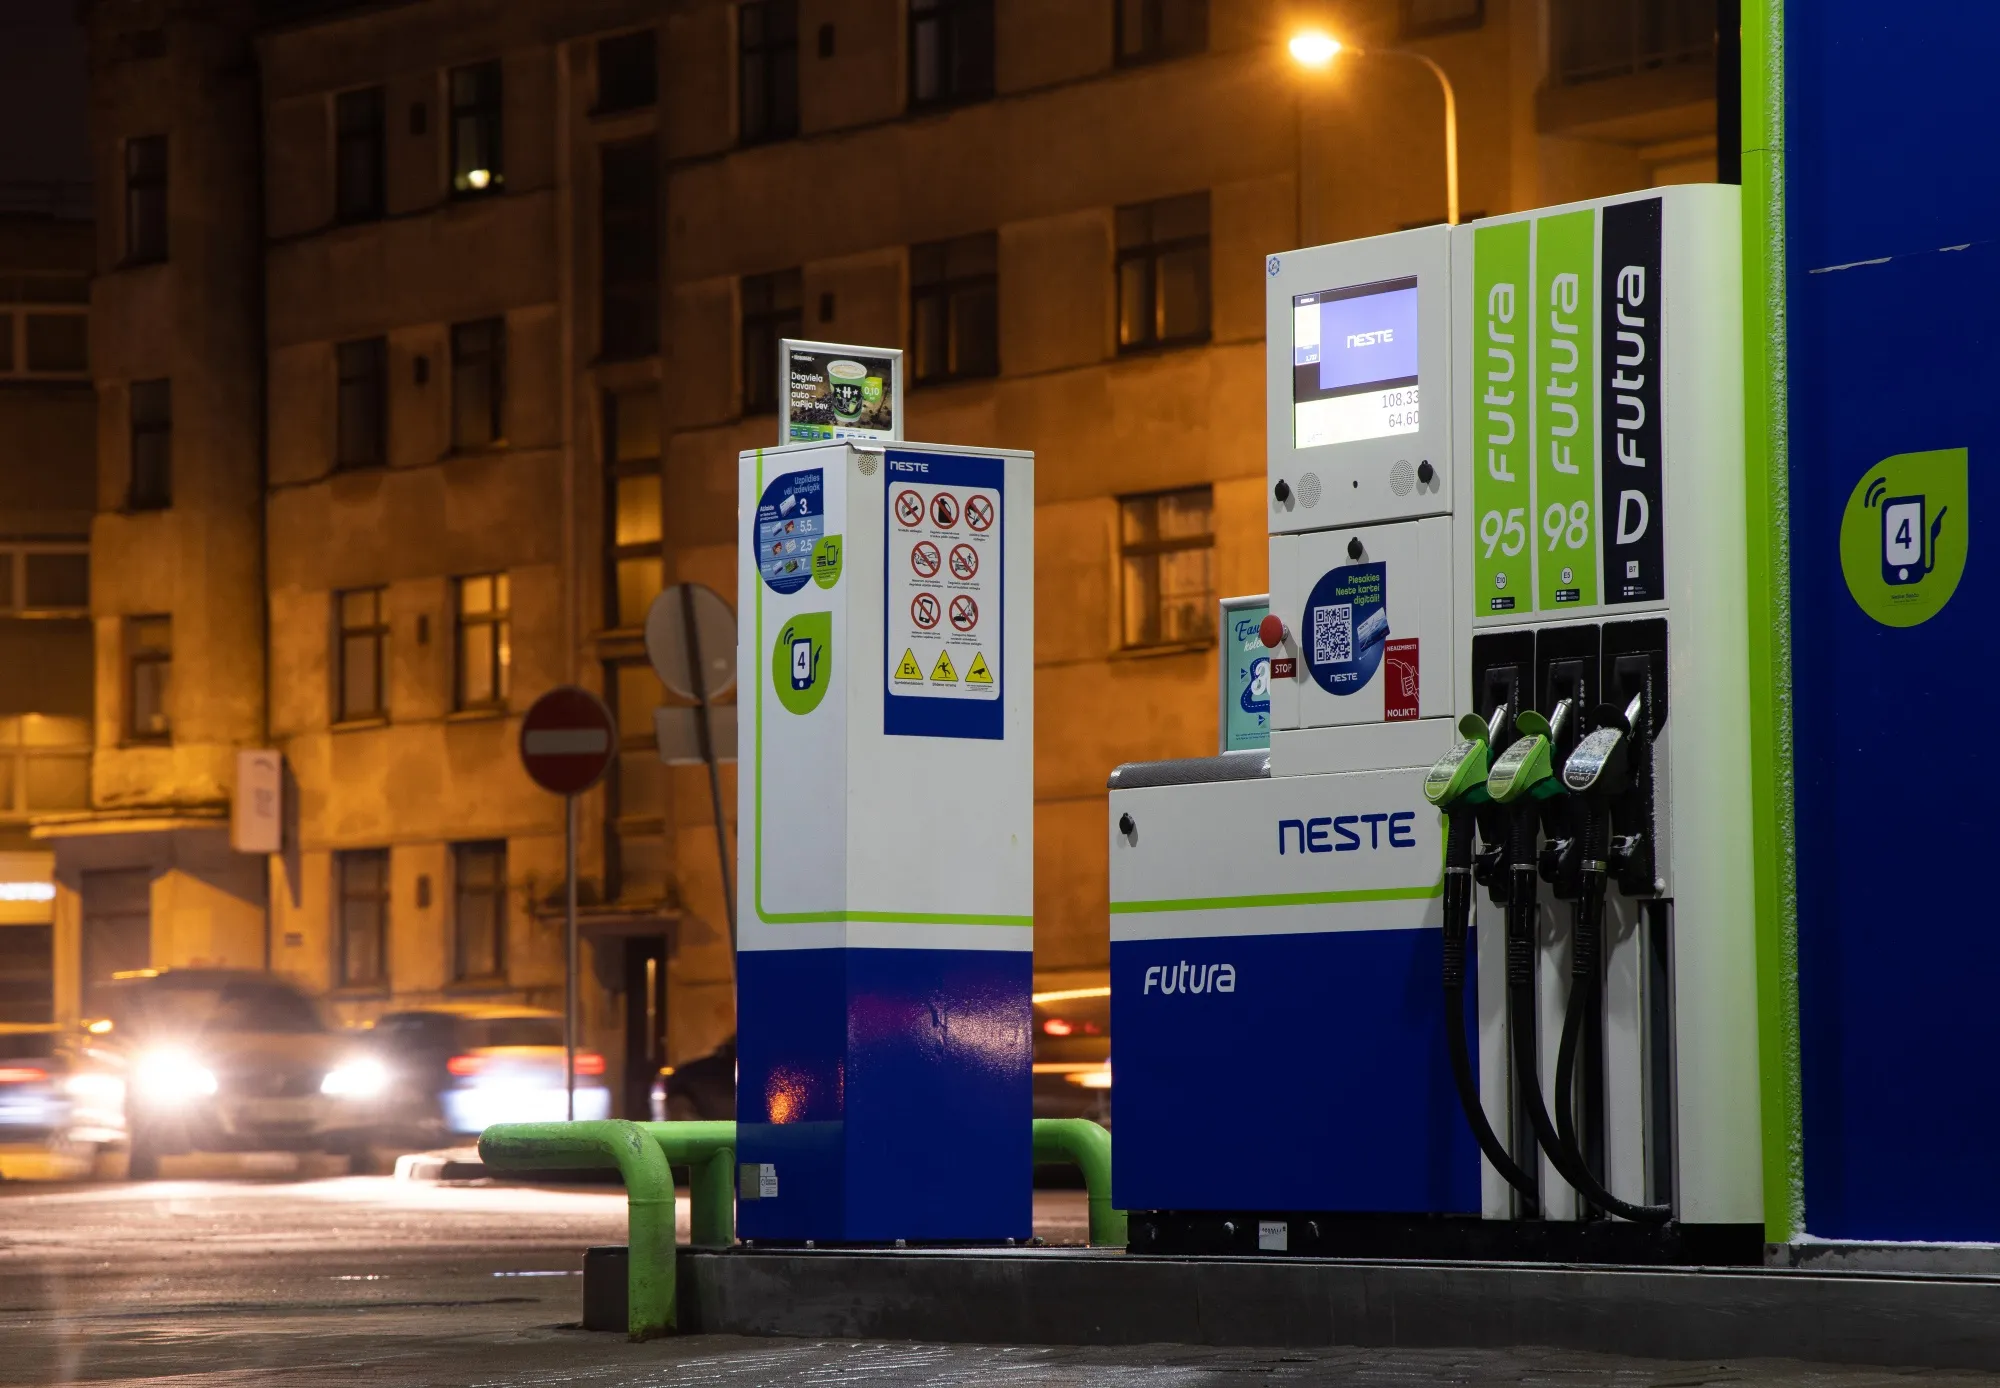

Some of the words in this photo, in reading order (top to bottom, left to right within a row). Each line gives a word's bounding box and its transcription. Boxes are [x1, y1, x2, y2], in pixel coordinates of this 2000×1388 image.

[1346, 329, 1394, 349] NESTE
[791, 371, 824, 383] Degviela
[791, 381, 817, 391] tavam
[863, 386, 880, 396] 0,10
[791, 391, 810, 399] auto
[791, 399, 813, 411] kafija
[814, 401, 828, 410] tev
[889, 460, 929, 473] NESTE
[794, 474, 820, 486] Uzpildies
[799, 498, 807, 515] 3
[1615, 489, 1649, 545] D
[800, 519, 812, 533] 5,5
[1542, 500, 1589, 552] 98
[1480, 508, 1525, 559] 95
[1895, 518, 1912, 549] 4
[800, 539, 812, 553] 2,5
[1348, 573, 1380, 585] Piesakies
[1563, 571, 1571, 579] E5
[1335, 587, 1356, 597] Neste
[1358, 584, 1380, 594] kartei
[1353, 595, 1380, 607] digitāli!
[797, 651, 806, 670] 4
[903, 663, 916, 675] Ex
[1274, 664, 1292, 674] STOP
[1330, 672, 1358, 683] NESTE
[1387, 708, 1417, 718] NOLIKT!
[1278, 811, 1416, 856] NESTE
[1143, 960, 1236, 996] Futura
